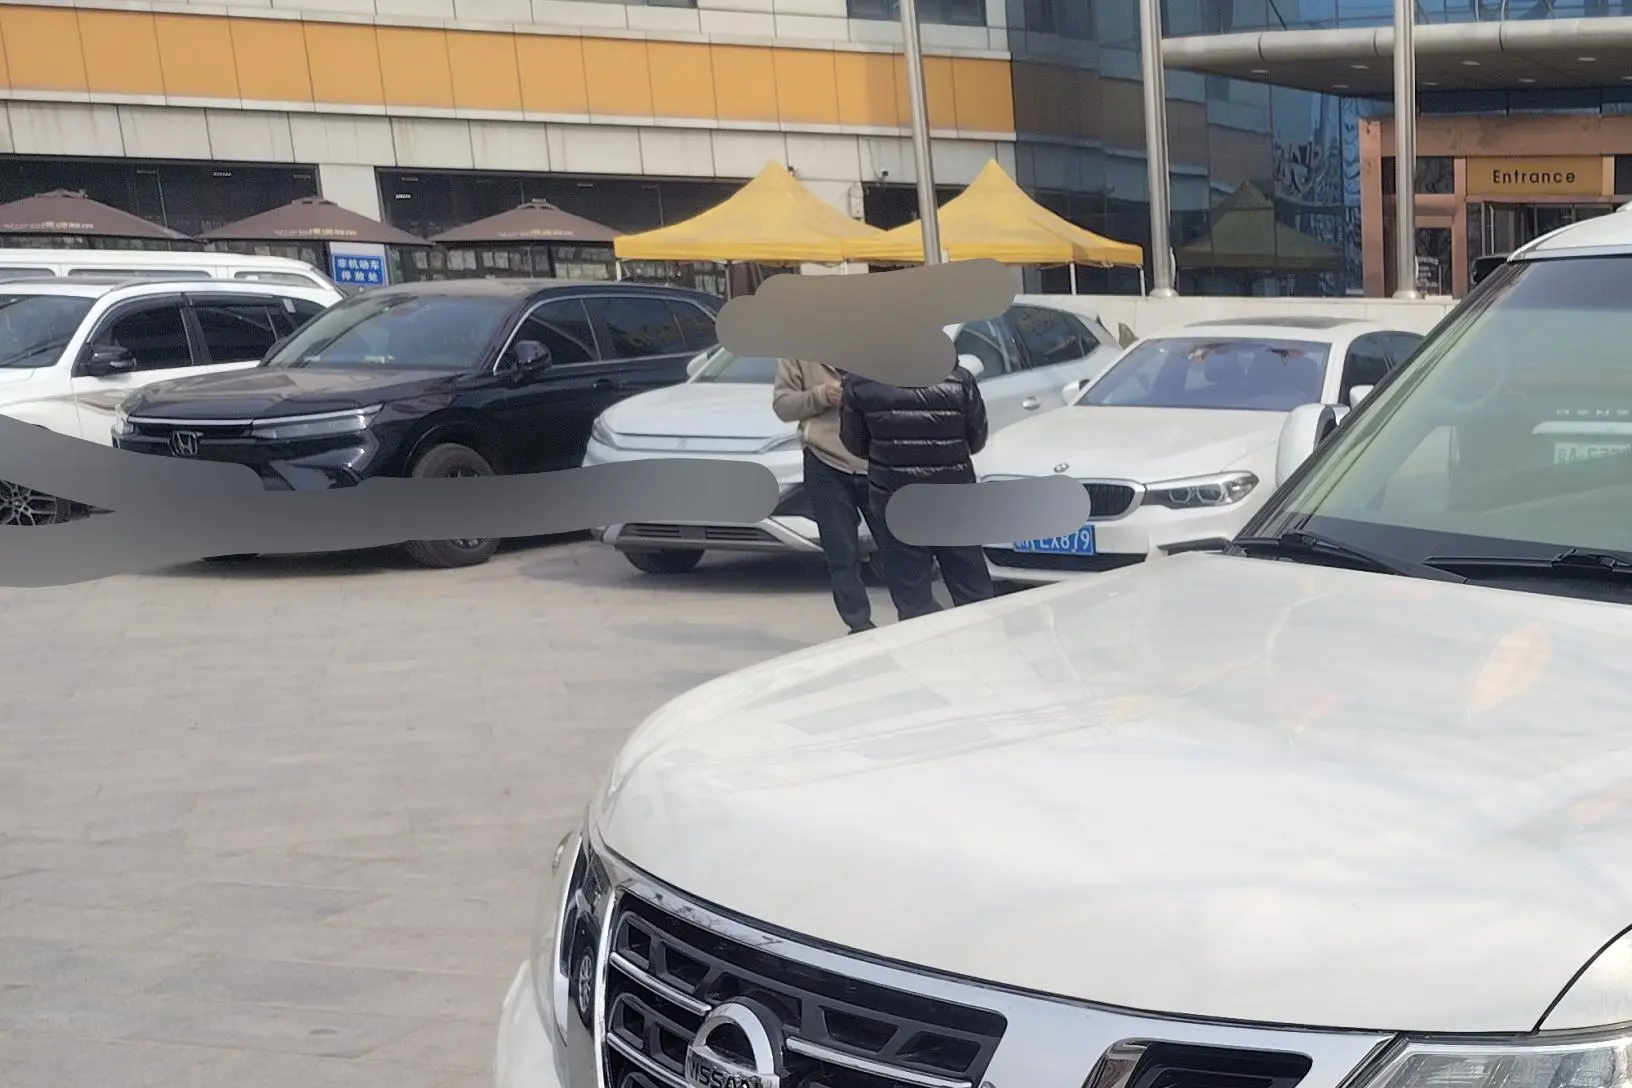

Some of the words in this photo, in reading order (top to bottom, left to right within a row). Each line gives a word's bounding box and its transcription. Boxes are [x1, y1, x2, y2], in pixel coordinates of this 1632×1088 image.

[1493, 169, 1576, 184] Entrance
[337, 258, 380, 270] 非机动车
